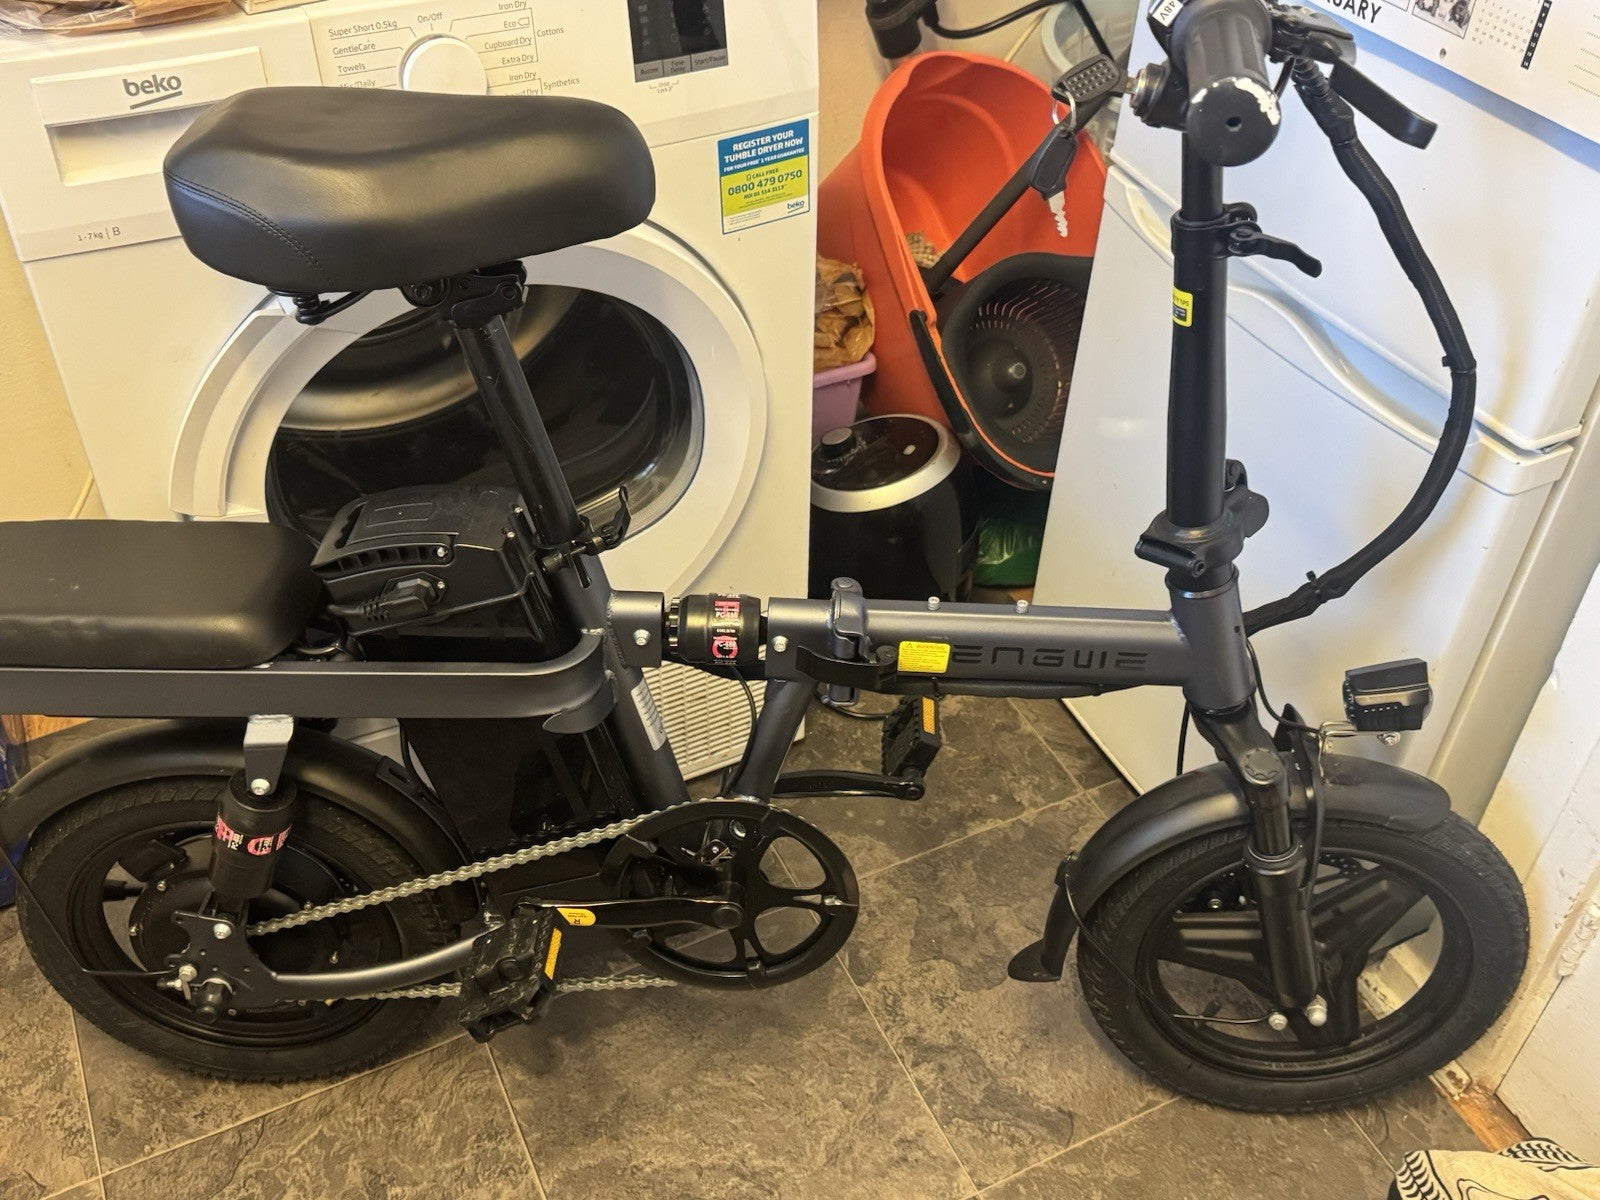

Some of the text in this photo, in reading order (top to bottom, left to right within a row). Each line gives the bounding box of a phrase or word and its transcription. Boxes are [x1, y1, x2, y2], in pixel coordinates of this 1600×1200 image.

[498, 0, 526, 10] Iron Dry
[418, 12, 442, 23] On/Off
[328, 20, 398, 38] Super Short 0.5kg
[536, 27, 564, 37] Cottons
[332, 42, 376, 55] GentleCare
[484, 36, 532, 50] Cupboard Dry
[502, 54, 534, 65] Extra Dry
[337, 62, 366, 73] Towels
[524, 71, 537, 80] Dry
[122, 74, 182, 97] beko
[543, 77, 580, 90] Synthetics
[732, 130, 794, 152] REGISTER YOUR
[724, 137, 804, 163] TUMBLE DRYER NOW
[728, 170, 802, 196] 0800 479 0750
[787, 200, 804, 210] beko
[112, 226, 121, 236] B
[952, 644, 1148, 671] ENGWE
